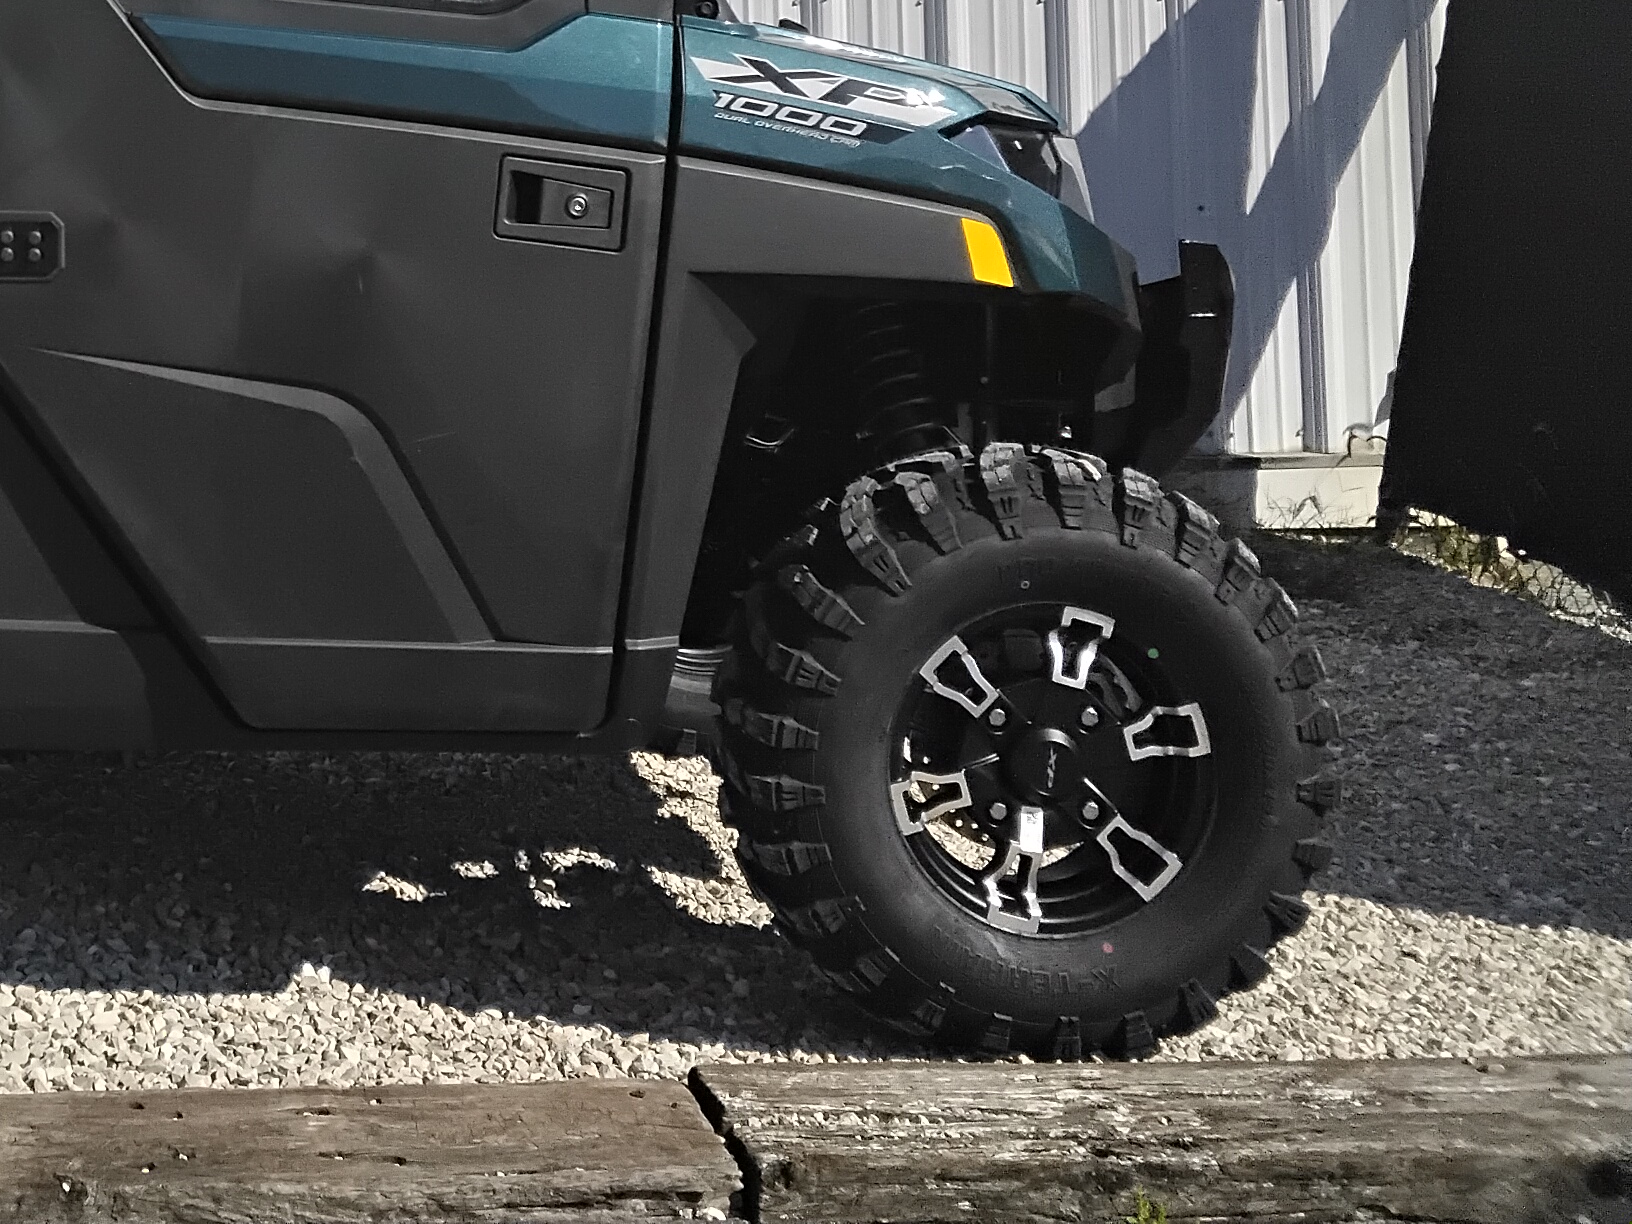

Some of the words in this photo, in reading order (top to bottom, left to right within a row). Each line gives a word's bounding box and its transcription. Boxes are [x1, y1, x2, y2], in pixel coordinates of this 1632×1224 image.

[708, 55, 948, 108] XP
[713, 111, 752, 126] DUAL
[714, 91, 868, 137] 1000
